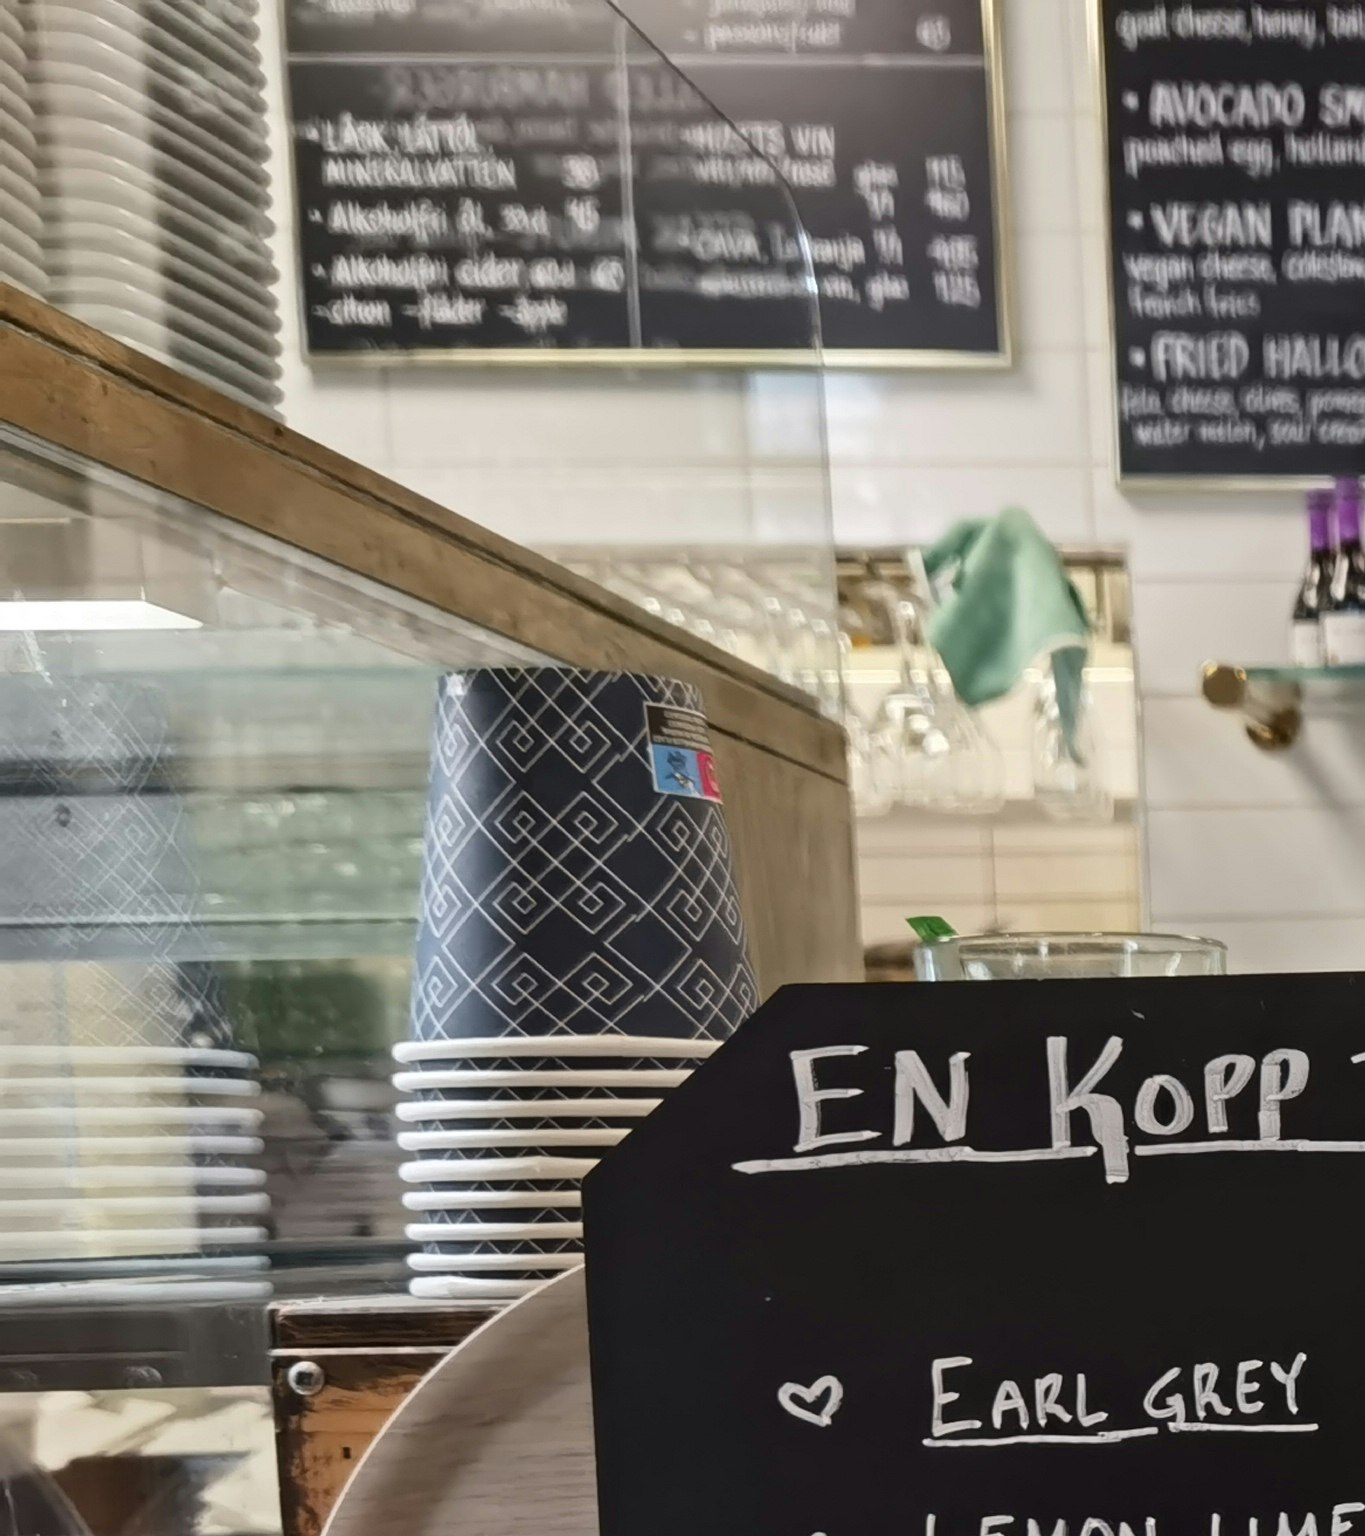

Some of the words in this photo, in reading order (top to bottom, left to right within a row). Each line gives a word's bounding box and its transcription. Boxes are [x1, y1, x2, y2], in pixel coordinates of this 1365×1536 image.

[1149, 81, 1305, 128] AVOCADO
[790, 122, 835, 157] VIN
[1150, 201, 1273, 249] VEGAN
[1151, 330, 1249, 382] FRIED
[790, 1043, 972, 1152] EN
[930, 1355, 1109, 1438] EARL
[1143, 1350, 1308, 1432] GREY
